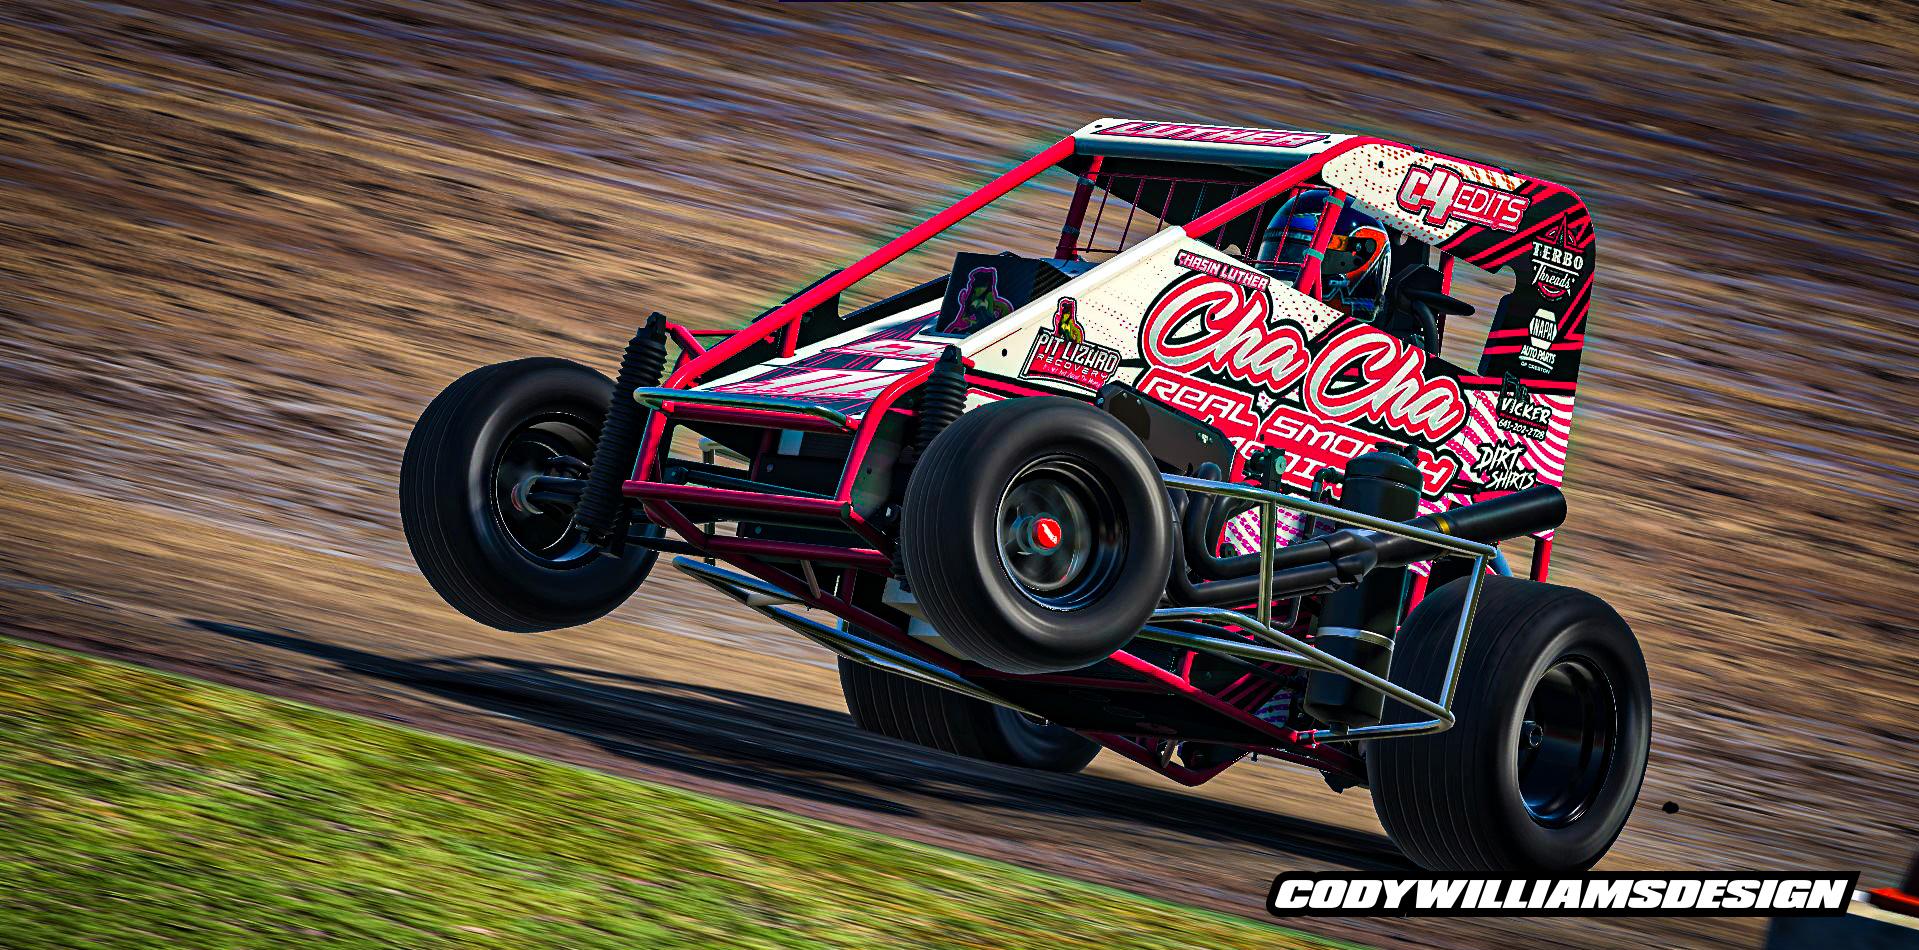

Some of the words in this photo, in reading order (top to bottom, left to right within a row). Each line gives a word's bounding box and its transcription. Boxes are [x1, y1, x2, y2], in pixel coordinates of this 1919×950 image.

[1453, 186, 1529, 222] EDITS
[1532, 241, 1584, 270] TERBO
[1178, 252, 1222, 275] CHASIN
[1220, 263, 1269, 290] LUTHER
[1532, 264, 1571, 289] Threads
[1534, 318, 1554, 341] NAPA
[1024, 333, 1065, 374] PIT
[1062, 341, 1118, 373] LIZARD
[1037, 353, 1109, 379] RECOVERY
[1148, 279, 1306, 380] Cha
[1308, 331, 1461, 432] Cha
[1521, 344, 1538, 359] AUTO
[1537, 349, 1556, 364] PARTS
[1501, 397, 1551, 424] VICKER
[1144, 376, 1253, 427] REAL
[1267, 416, 1449, 484] SMOH
[1474, 445, 1526, 474] DIRT
[1485, 470, 1535, 490] SHIRTS
